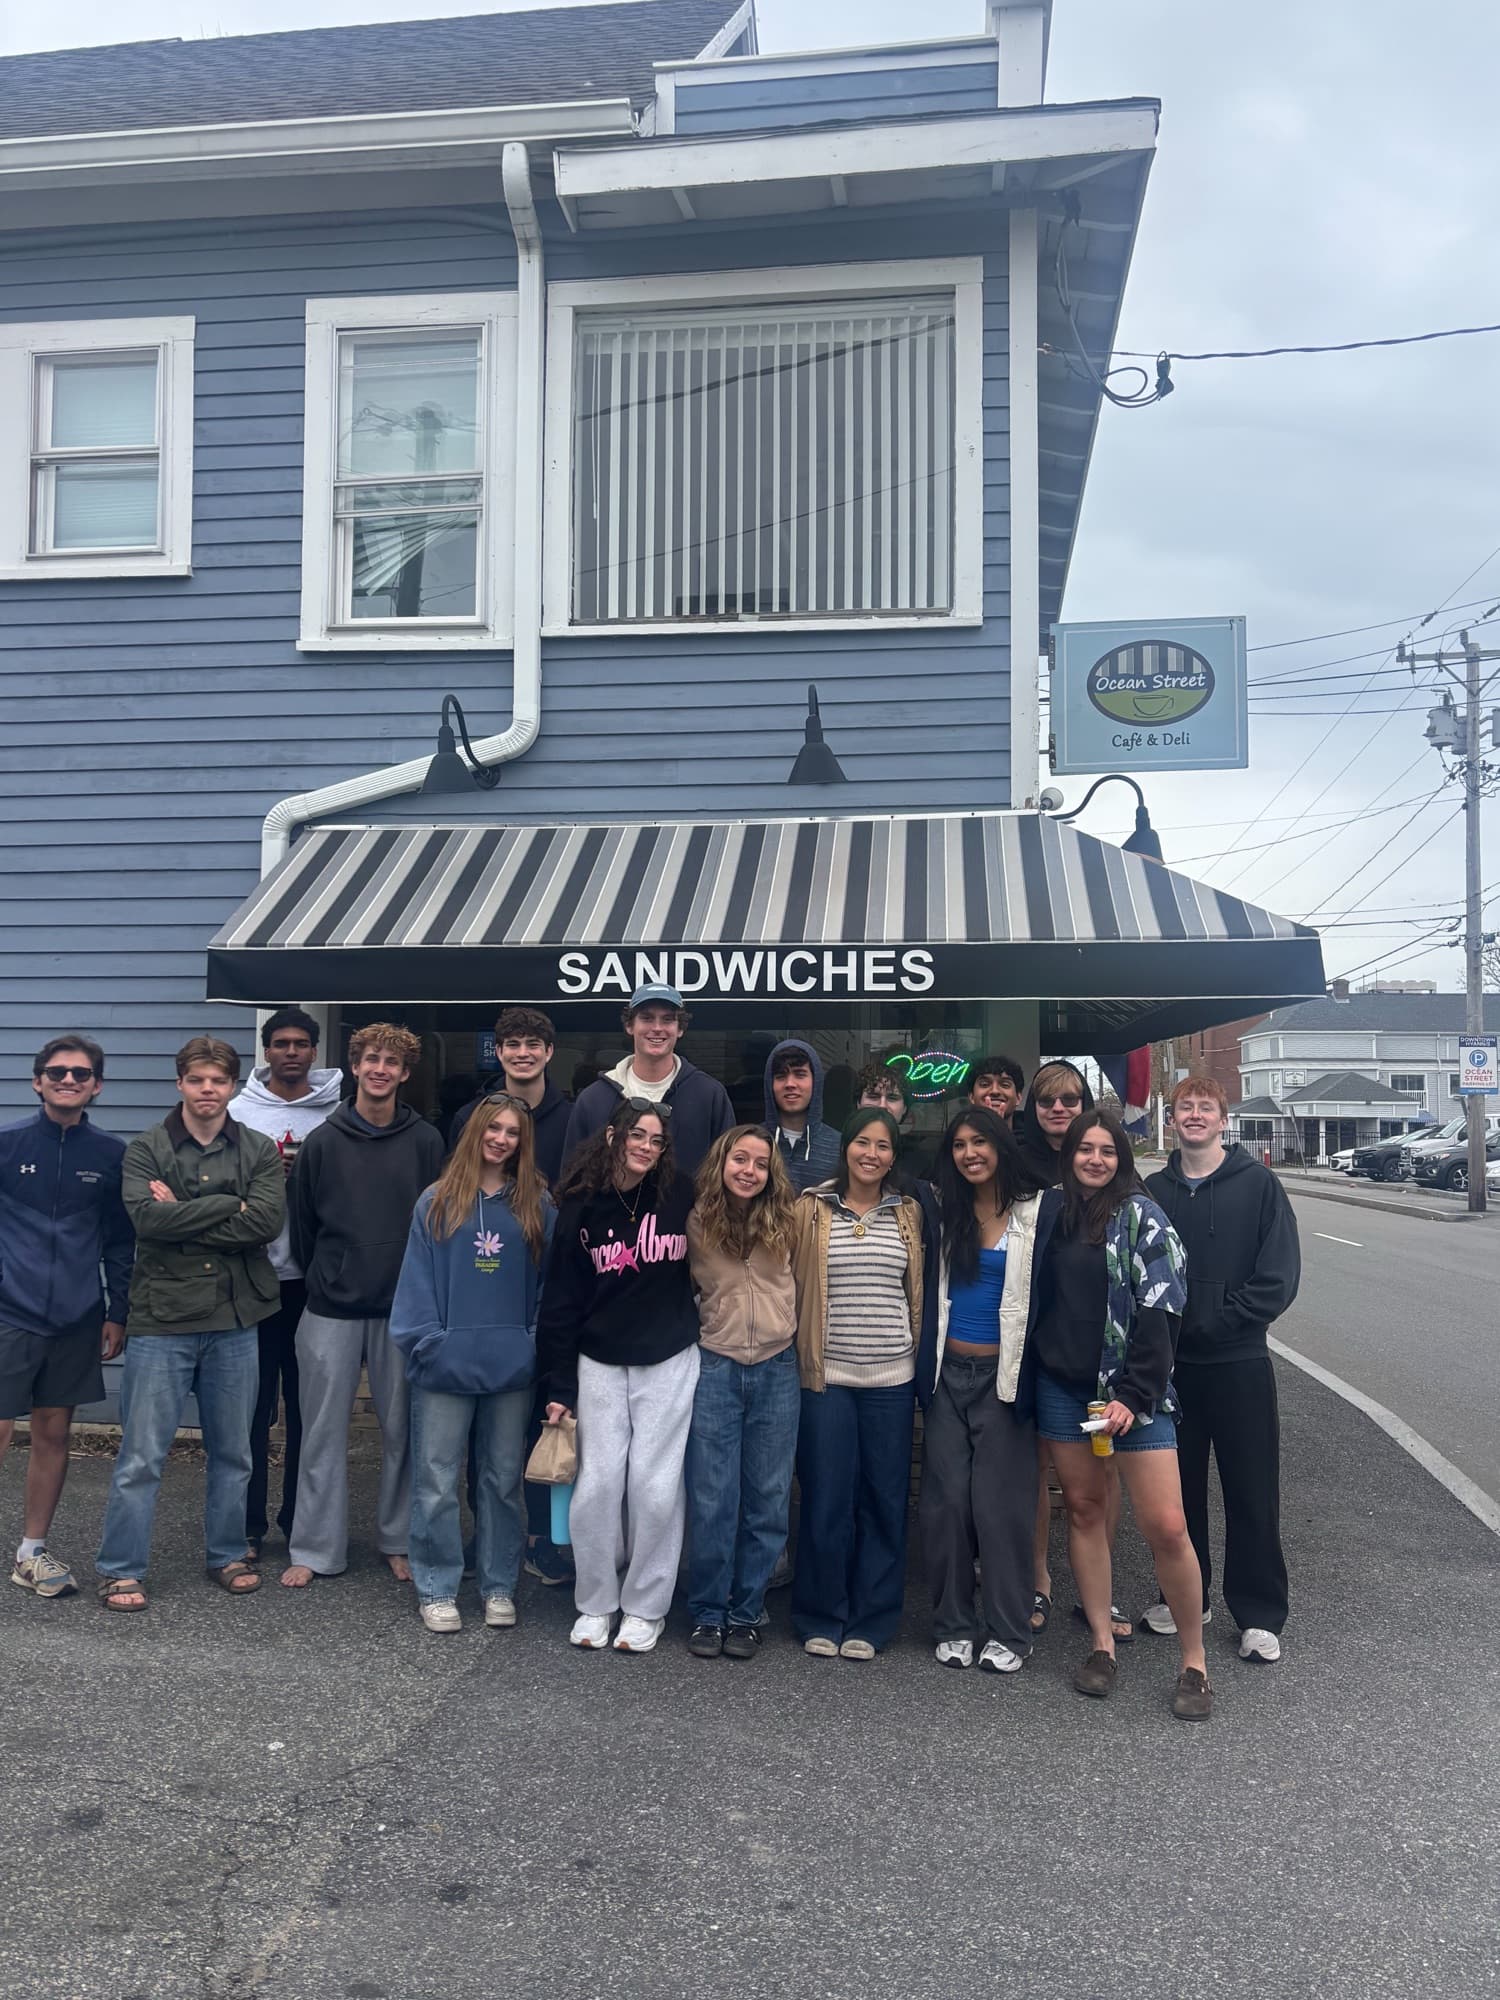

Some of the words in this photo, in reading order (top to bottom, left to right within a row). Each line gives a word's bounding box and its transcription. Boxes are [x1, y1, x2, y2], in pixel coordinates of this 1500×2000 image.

[1095, 677, 1147, 691] Ocean
[1152, 673, 1206, 689] Street
[1111, 732, 1143, 751] Café
[1146, 733, 1159, 746] &
[1162, 732, 1191, 746] Deli
[556, 949, 936, 995] SANDWICHES
